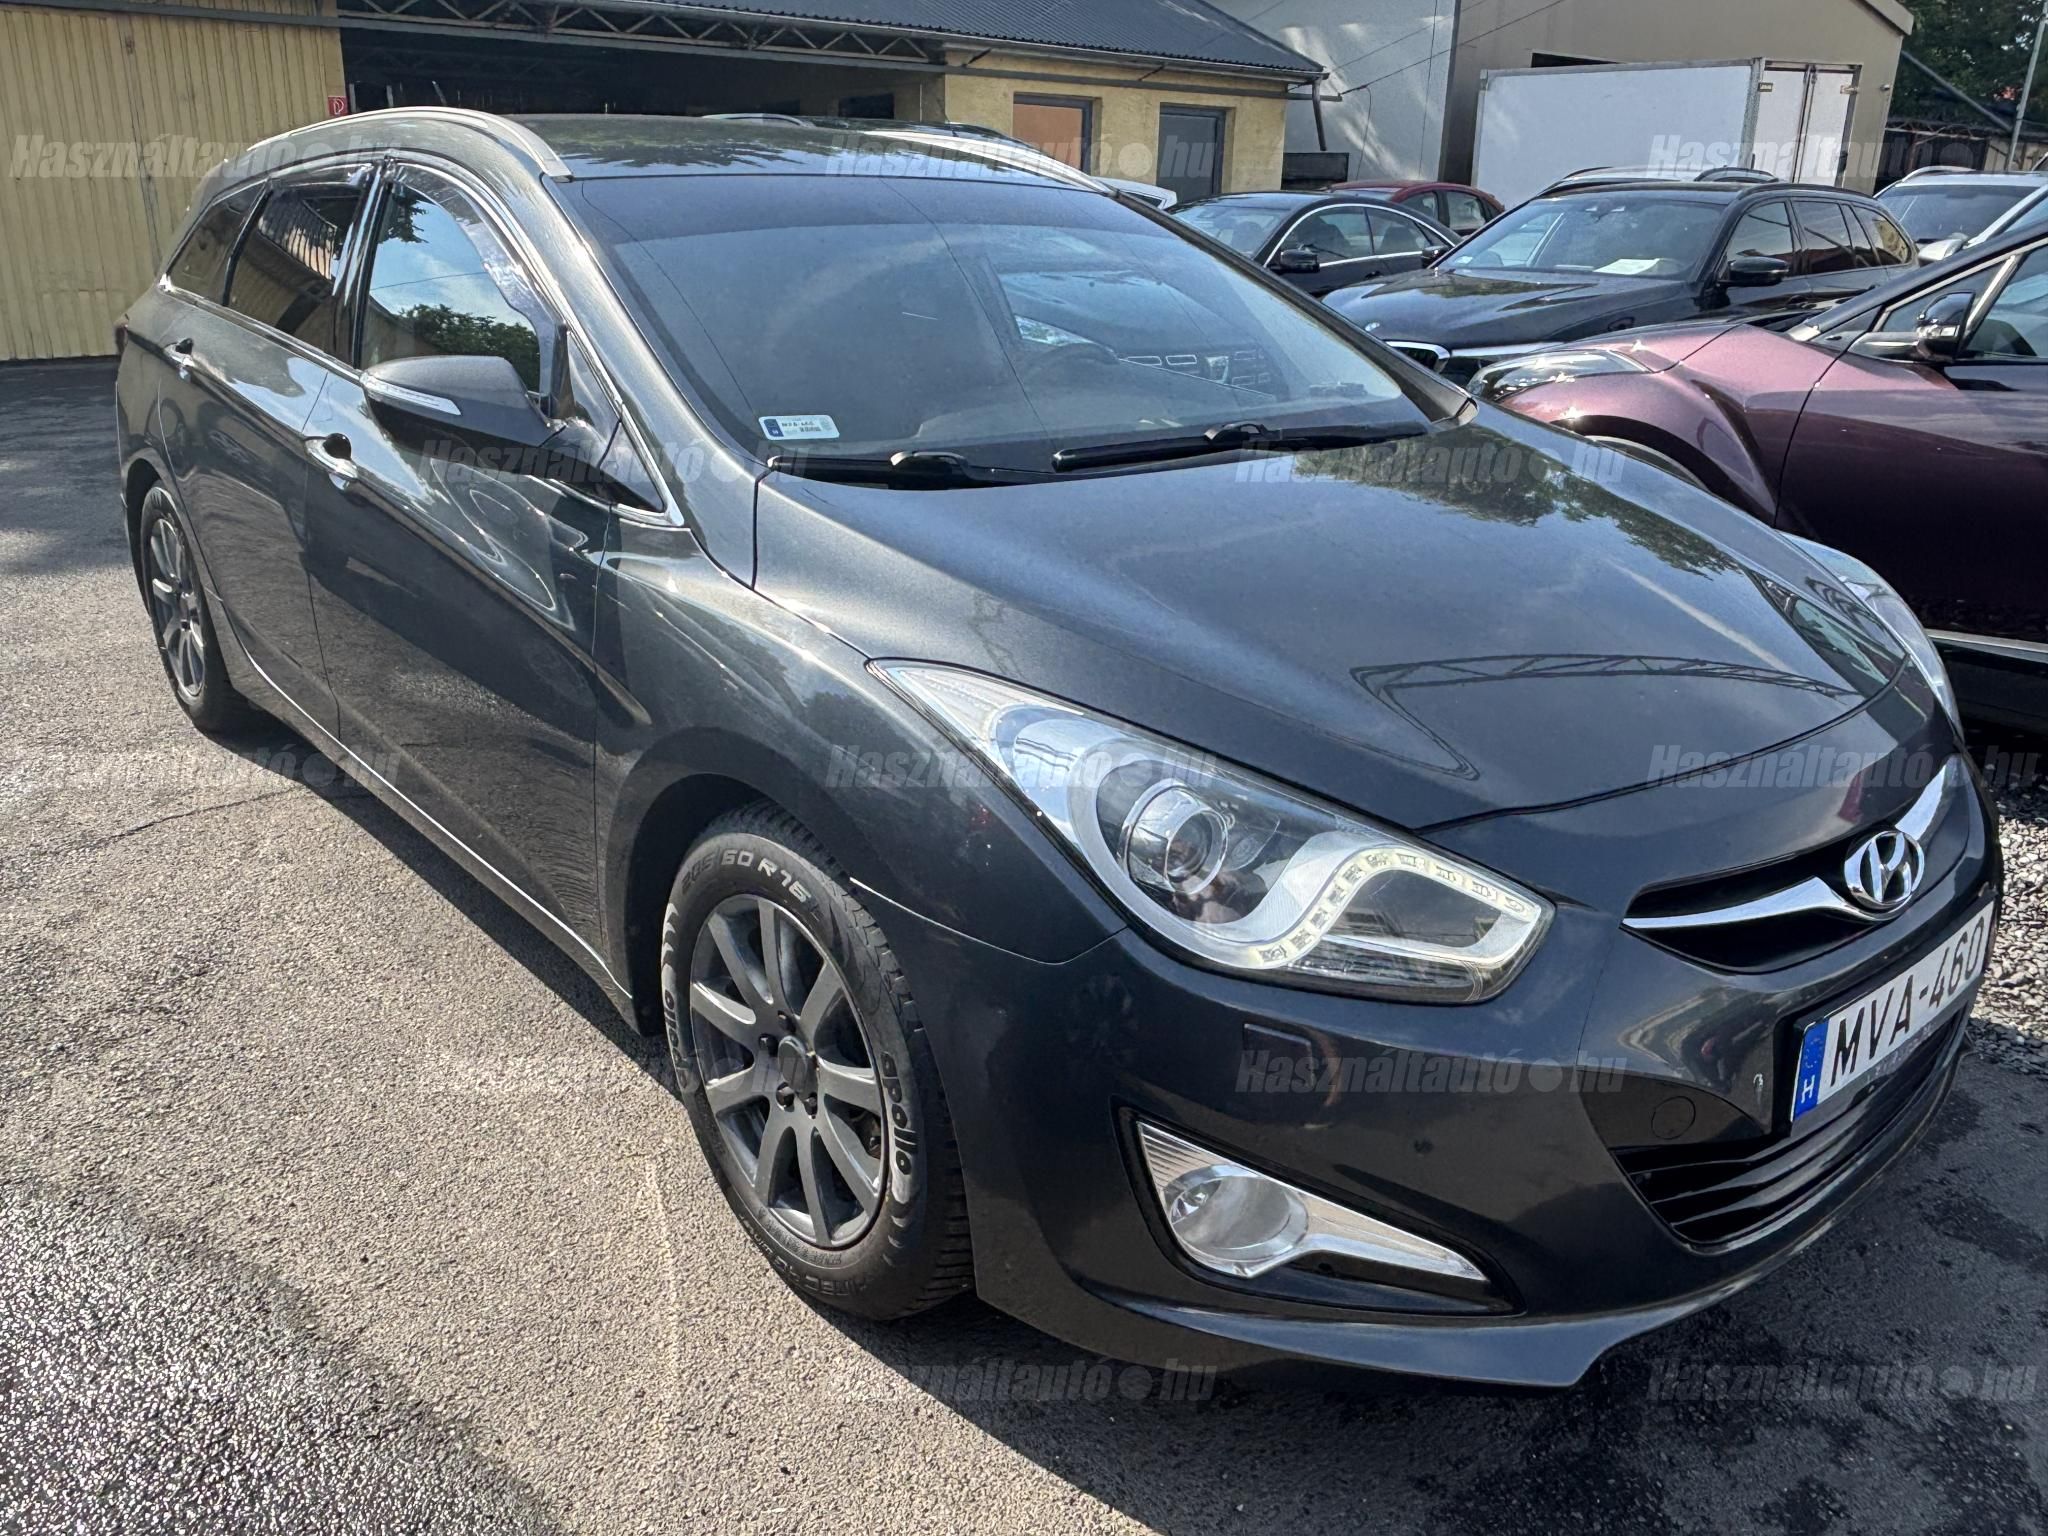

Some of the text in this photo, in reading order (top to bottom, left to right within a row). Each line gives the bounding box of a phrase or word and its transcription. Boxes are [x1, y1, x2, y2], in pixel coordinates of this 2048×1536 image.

[664, 989, 688, 1089] apollo
[1831, 916, 1984, 1087] MVA-460
[880, 1051, 918, 1175] apollo
[1801, 1074, 1815, 1104] H
